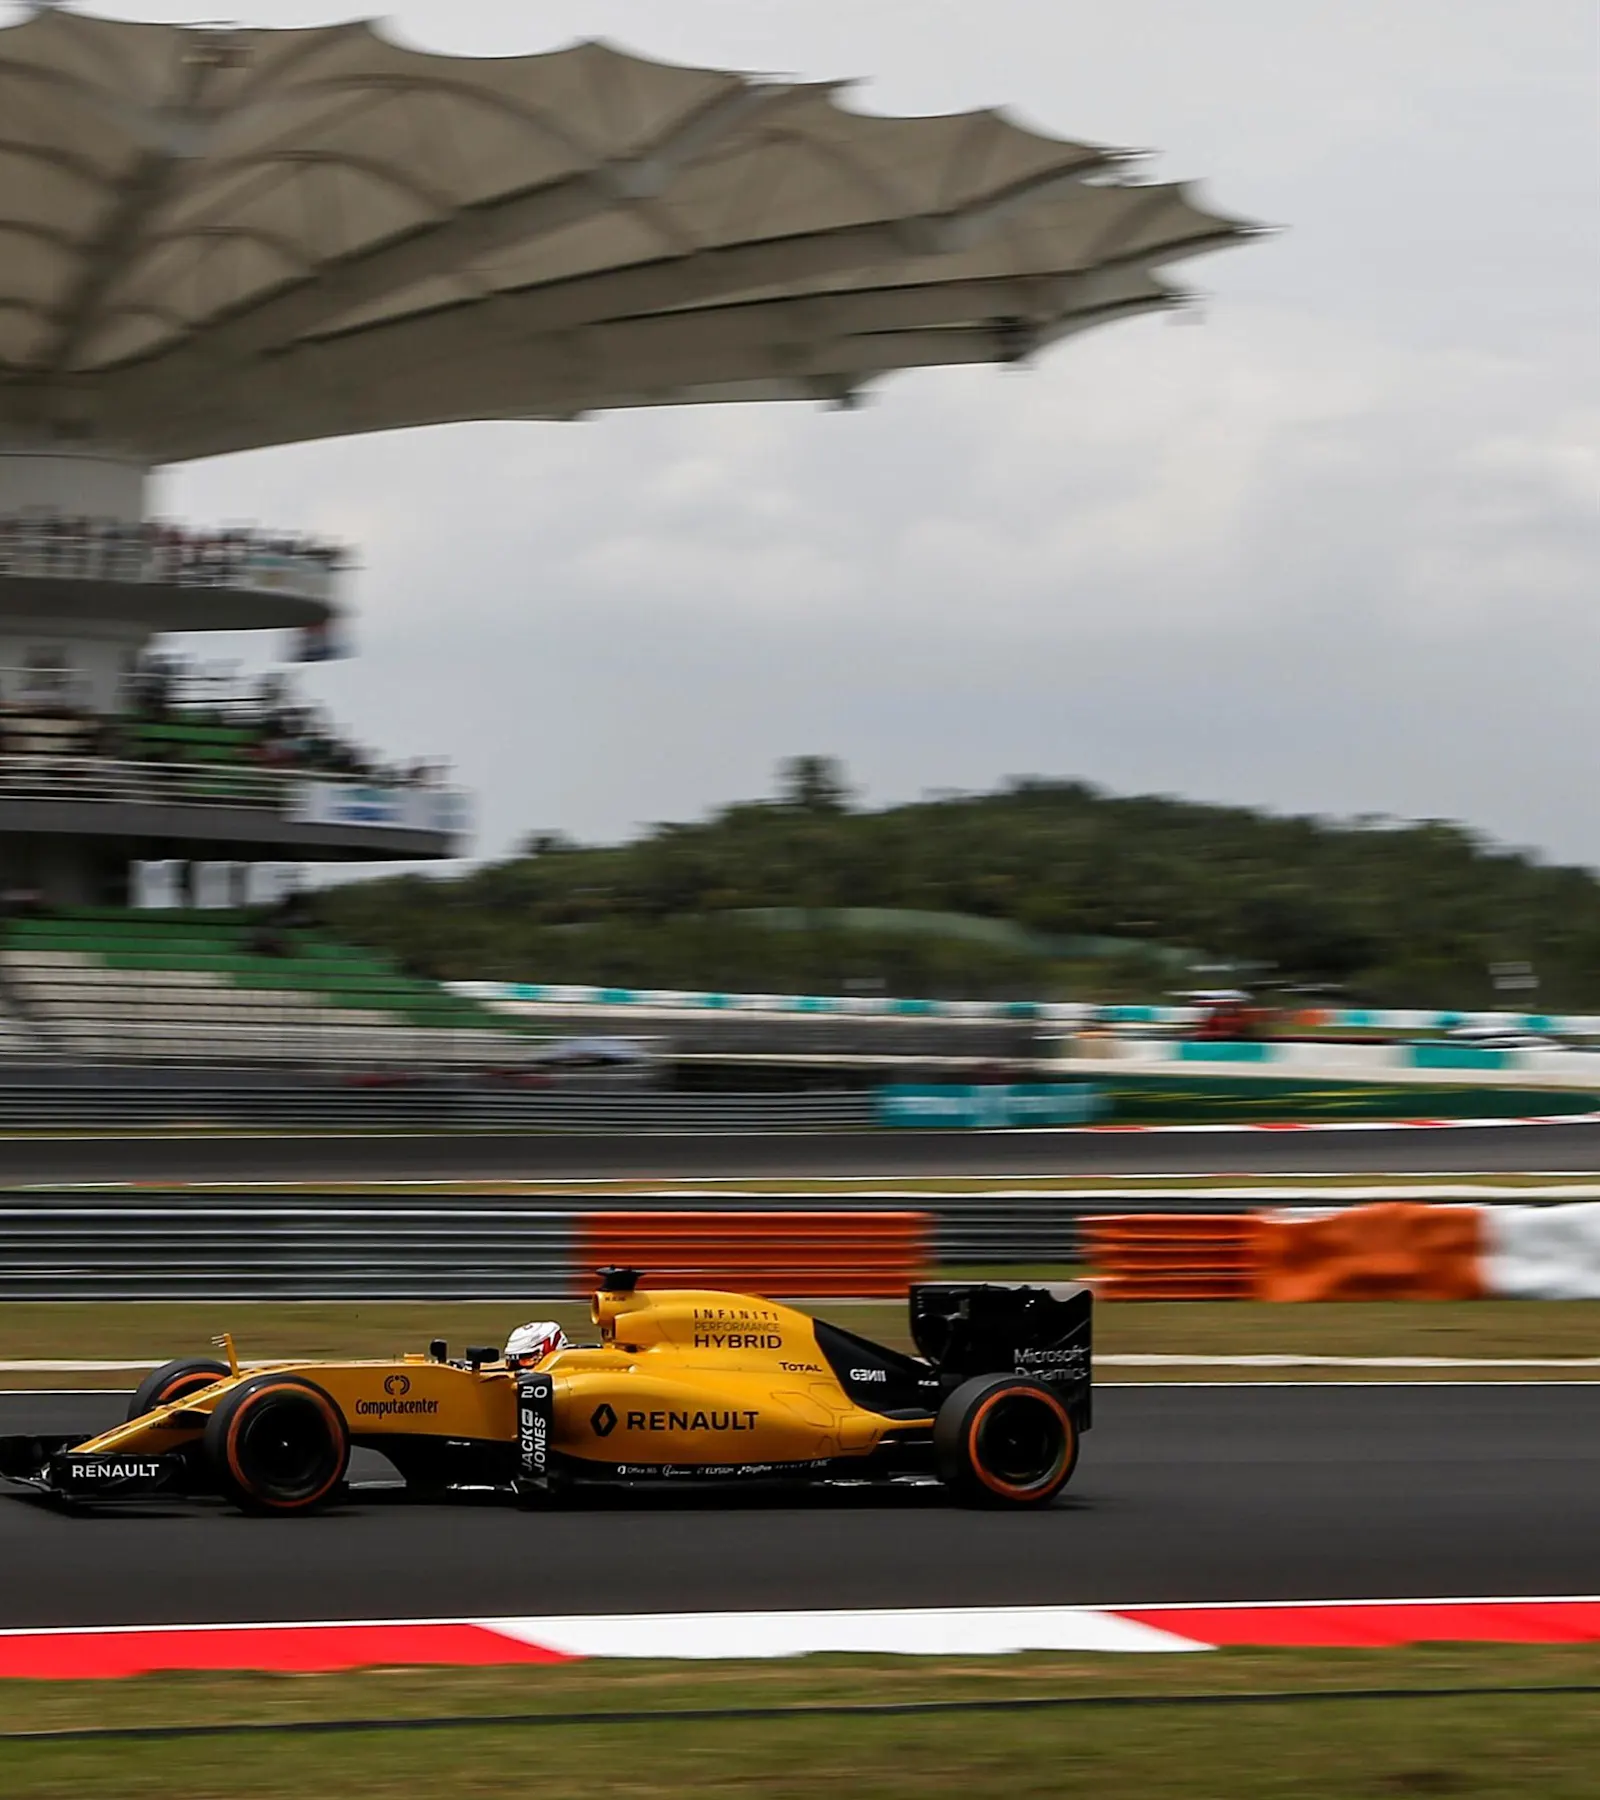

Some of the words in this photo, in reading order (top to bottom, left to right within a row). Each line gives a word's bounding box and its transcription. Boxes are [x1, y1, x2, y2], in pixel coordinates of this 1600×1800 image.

[694, 1309, 778, 1321] INFINITI
[695, 1322, 780, 1332] PERFORMANCE
[694, 1334, 782, 1349] HYBRID
[1014, 1345, 1085, 1363] Microsoft
[521, 1386, 547, 1398] 20
[355, 1398, 439, 1420] Computacenter
[627, 1411, 759, 1430] RENAULT
[521, 1427, 533, 1472] JACK
[534, 1417, 546, 1472] JONES
[72, 1464, 159, 1478] RENAULT
